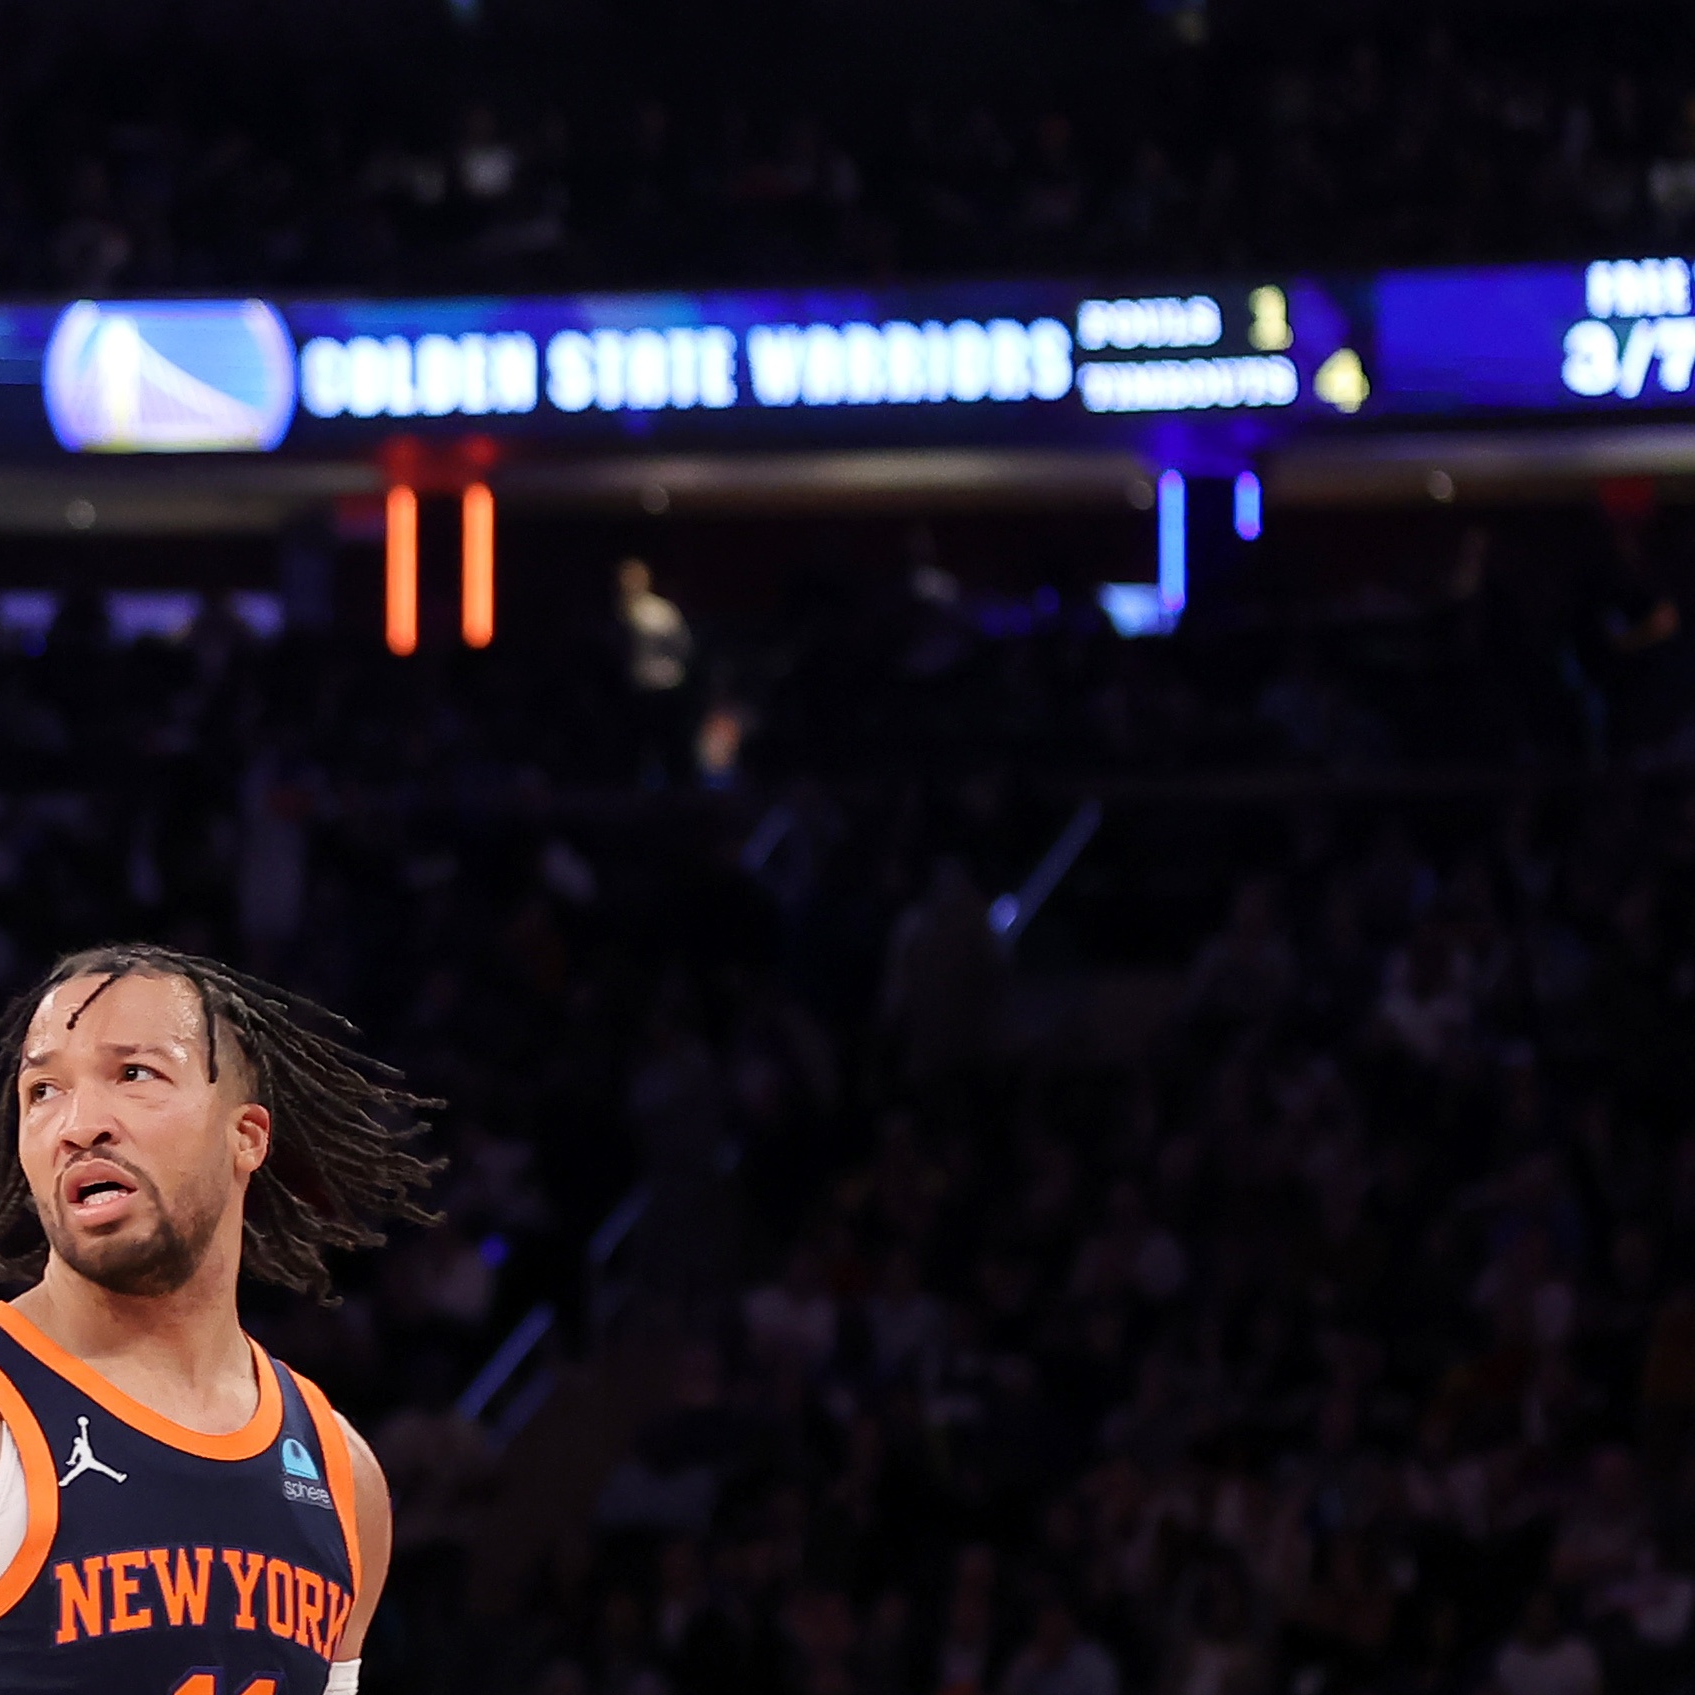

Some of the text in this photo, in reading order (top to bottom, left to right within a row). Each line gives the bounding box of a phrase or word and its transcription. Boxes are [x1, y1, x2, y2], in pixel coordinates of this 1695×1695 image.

[301, 316, 1074, 418] GOLDEN STATE WARRIORS
[283, 1479, 333, 1505] sphere
[55, 1547, 352, 1662] NEW YORK
